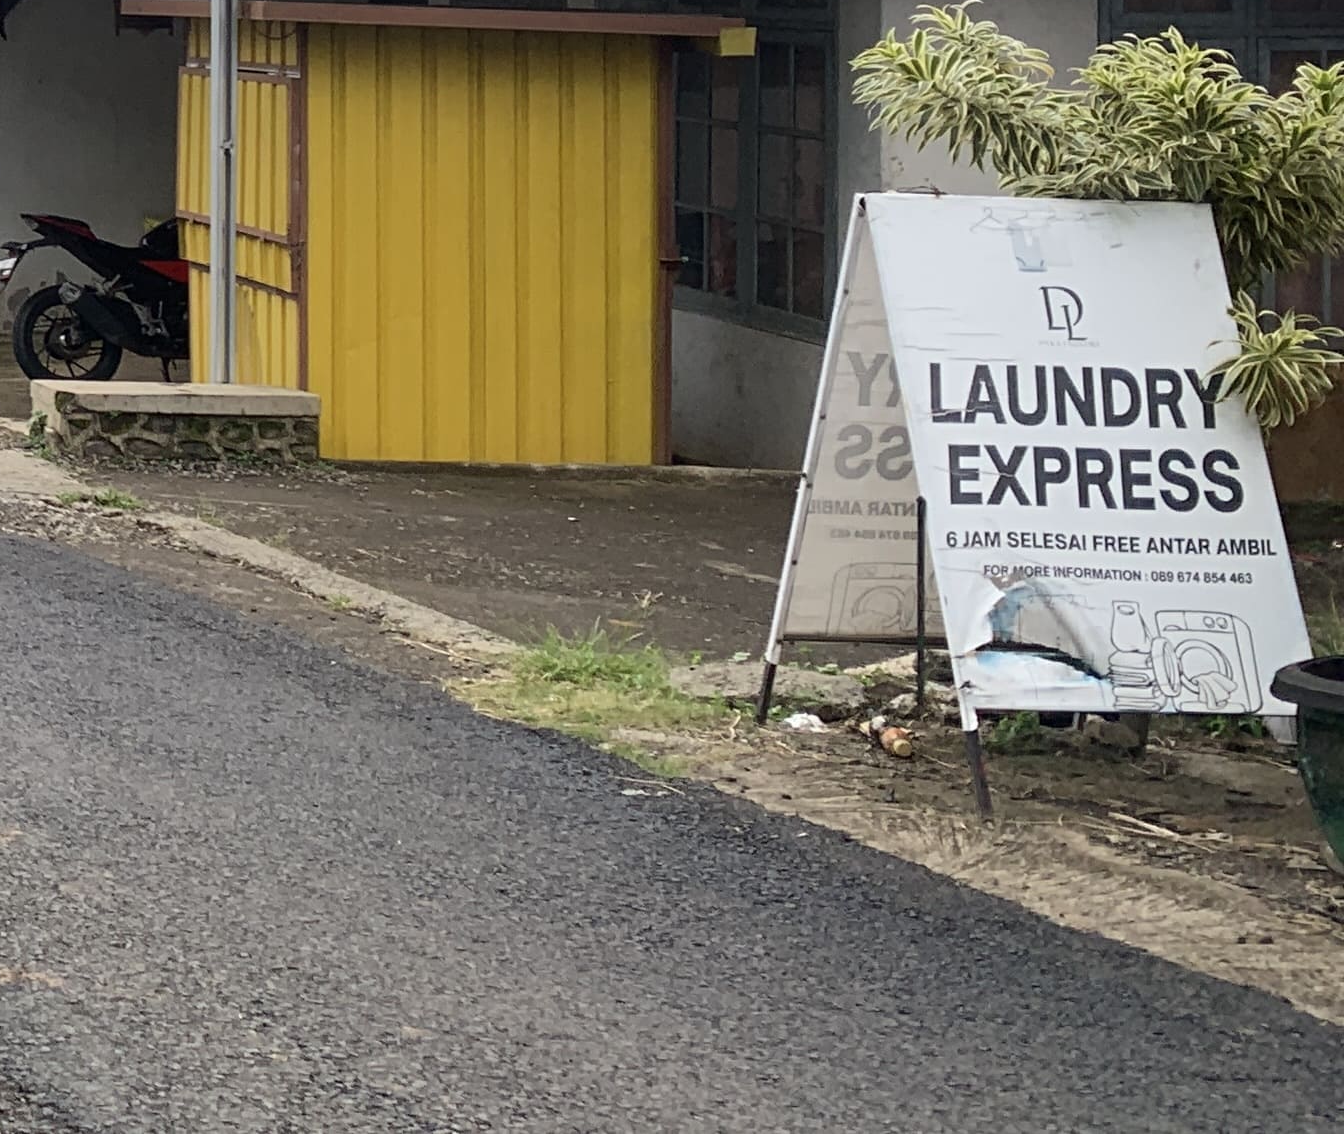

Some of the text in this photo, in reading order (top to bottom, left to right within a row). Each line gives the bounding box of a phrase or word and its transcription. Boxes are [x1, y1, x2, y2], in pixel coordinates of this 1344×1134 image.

[929, 362, 1225, 429] LAUNDRY
[948, 444, 1244, 513] EXPRESS
[946, 531, 1277, 556] 6 JAM SELESAI FREE ANTAR AMBIL
[983, 565, 1009, 576] FOR
[1013, 565, 1050, 578] MORE
[1053, 566, 1142, 581] INFORMATION
[1150, 570, 1174, 583] 089
[1177, 572, 1200, 583] 674
[1203, 572, 1226, 584] 854
[1229, 573, 1253, 585] 463
